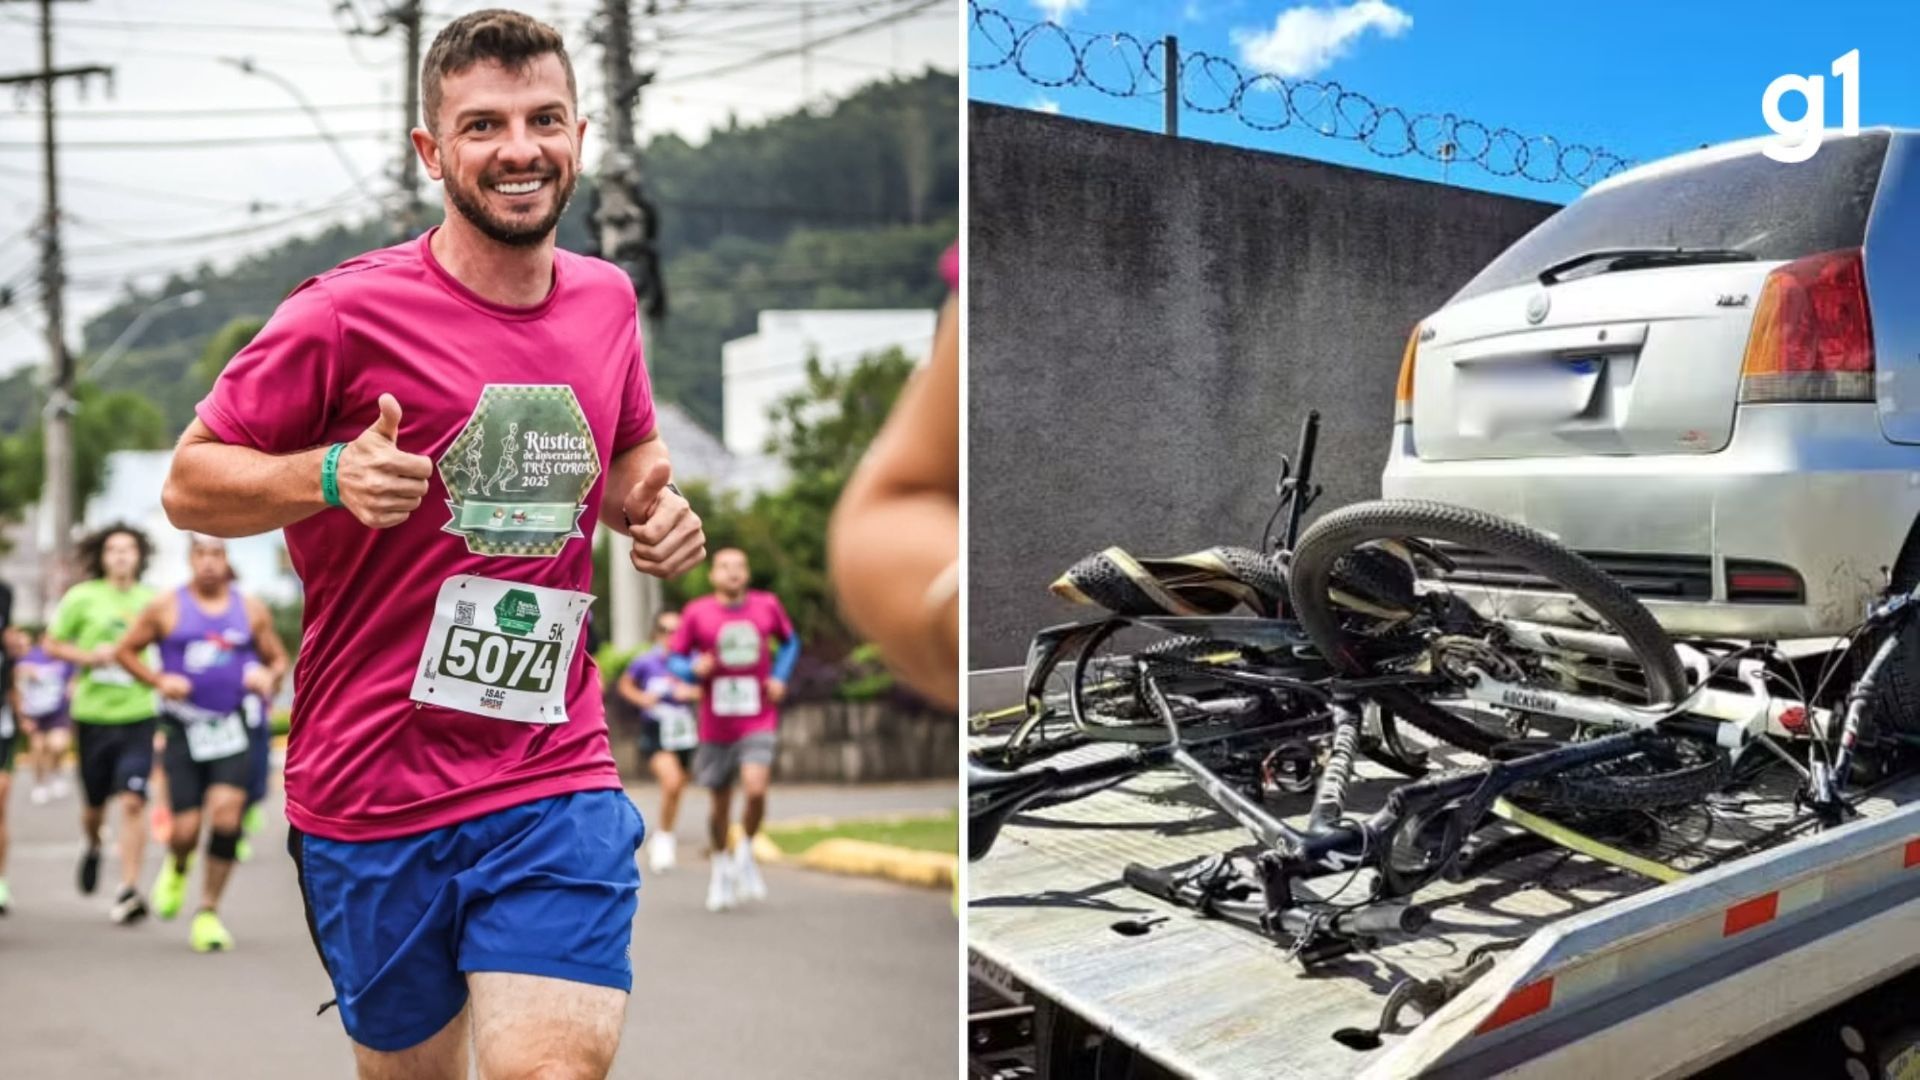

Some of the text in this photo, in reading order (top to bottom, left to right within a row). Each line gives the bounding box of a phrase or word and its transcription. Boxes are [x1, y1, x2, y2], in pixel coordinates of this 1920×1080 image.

[523, 430, 586, 452] Rústica
[523, 450, 533, 460] de
[535, 451, 581, 460] aniversário
[522, 460, 551, 475] TRÊS
[522, 476, 549, 487] 2025
[446, 628, 552, 690] 5074
[485, 688, 506, 699] ISAC
